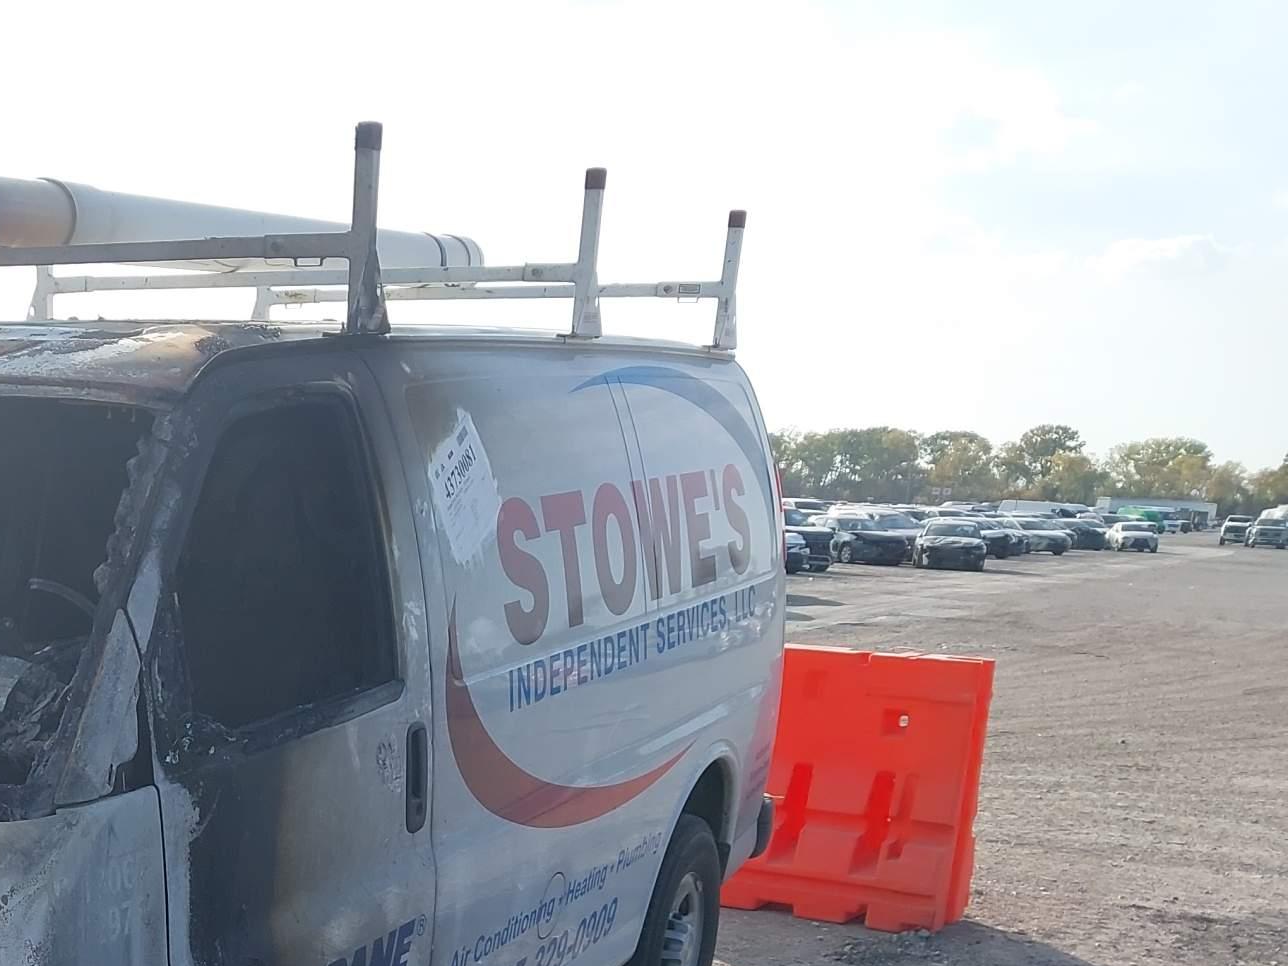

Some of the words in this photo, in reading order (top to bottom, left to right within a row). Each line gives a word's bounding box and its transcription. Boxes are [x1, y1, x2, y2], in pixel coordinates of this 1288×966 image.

[444, 443, 476, 499] 43730081
[497, 463, 752, 646] STOWE'S
[508, 621, 650, 712] INDEPENDENT
[735, 585, 756, 623] LLC
[474, 899, 555, 962] Conditioning
[565, 869, 608, 905] Heating
[616, 832, 663, 874] Plumbing
